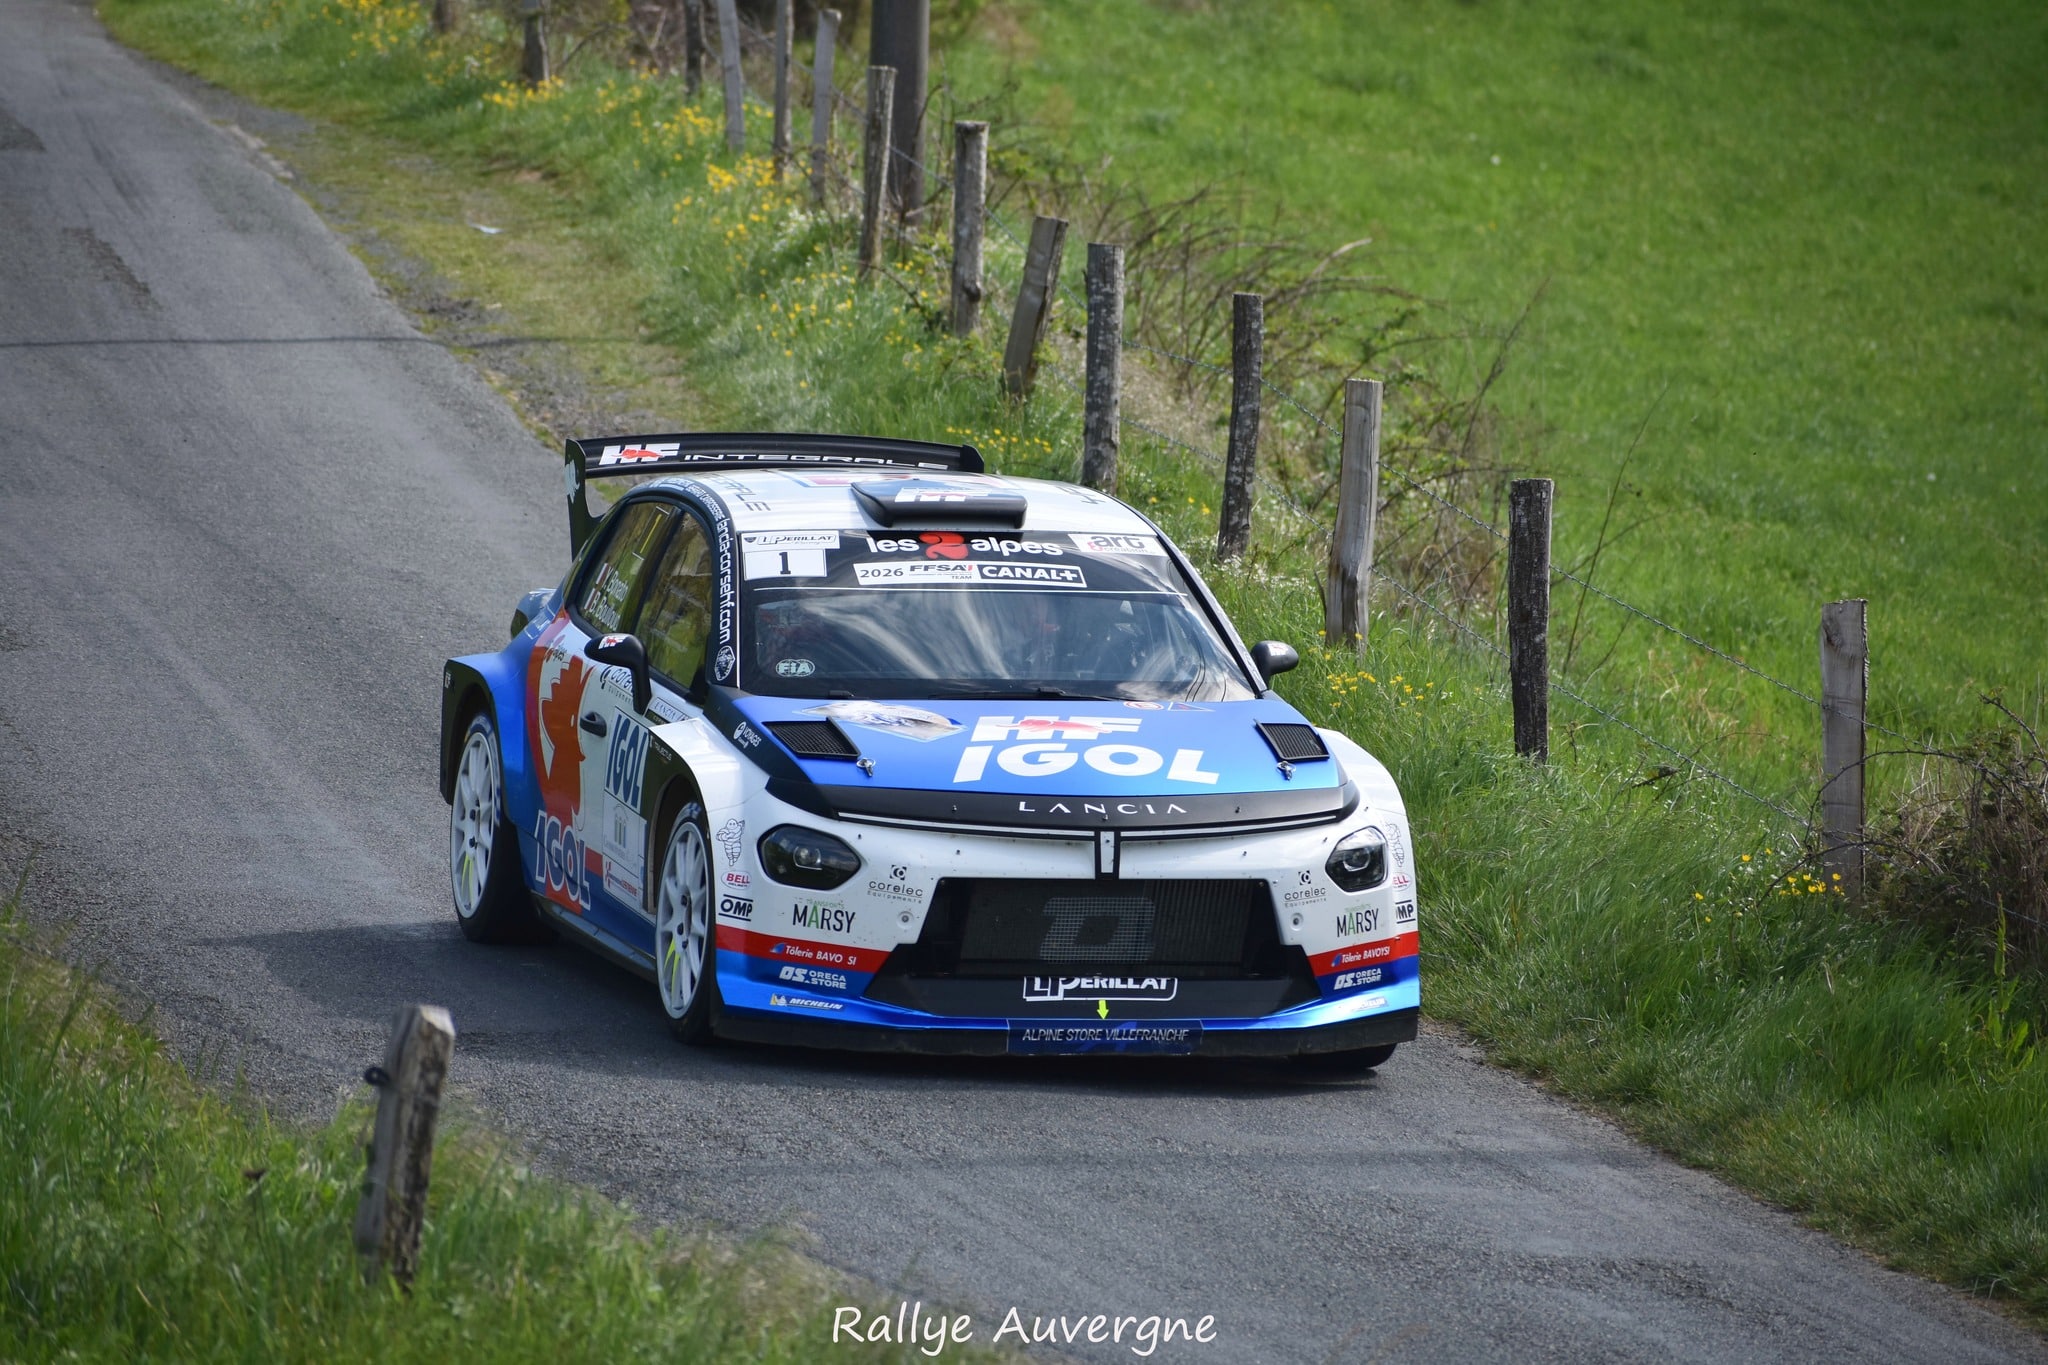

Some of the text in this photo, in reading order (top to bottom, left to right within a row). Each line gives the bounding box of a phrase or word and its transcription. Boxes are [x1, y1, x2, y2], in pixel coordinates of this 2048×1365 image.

[685, 453, 949, 470] INTEGRALE
[866, 537, 920, 553] les
[970, 537, 1063, 556] alpes
[779, 551, 791, 575] 1
[860, 568, 904, 578] 2026
[983, 564, 1078, 581] CANAL+
[778, 662, 812, 674] FIA
[970, 716, 1142, 742] HF
[606, 714, 648, 809] IGOL
[953, 743, 1220, 784] IGOL
[1019, 801, 1187, 815] LANCIA
[535, 810, 591, 911] IGOL
[726, 873, 750, 884] BELL
[869, 881, 923, 897] corelec
[1284, 887, 1326, 901] corelec
[720, 899, 753, 917] OMP
[793, 904, 856, 934] MARSY
[1336, 908, 1379, 938] MARSY
[786, 945, 813, 958] Tôlerie
[809, 970, 846, 982] ORECA
[1356, 968, 1381, 978] ORECA
[1357, 975, 1381, 985] STORE
[811, 978, 847, 989] STORE
[789, 998, 843, 1010] MICHELIN
[1023, 1029, 1063, 1041] ALPINE
[1066, 1029, 1102, 1041] STORE
